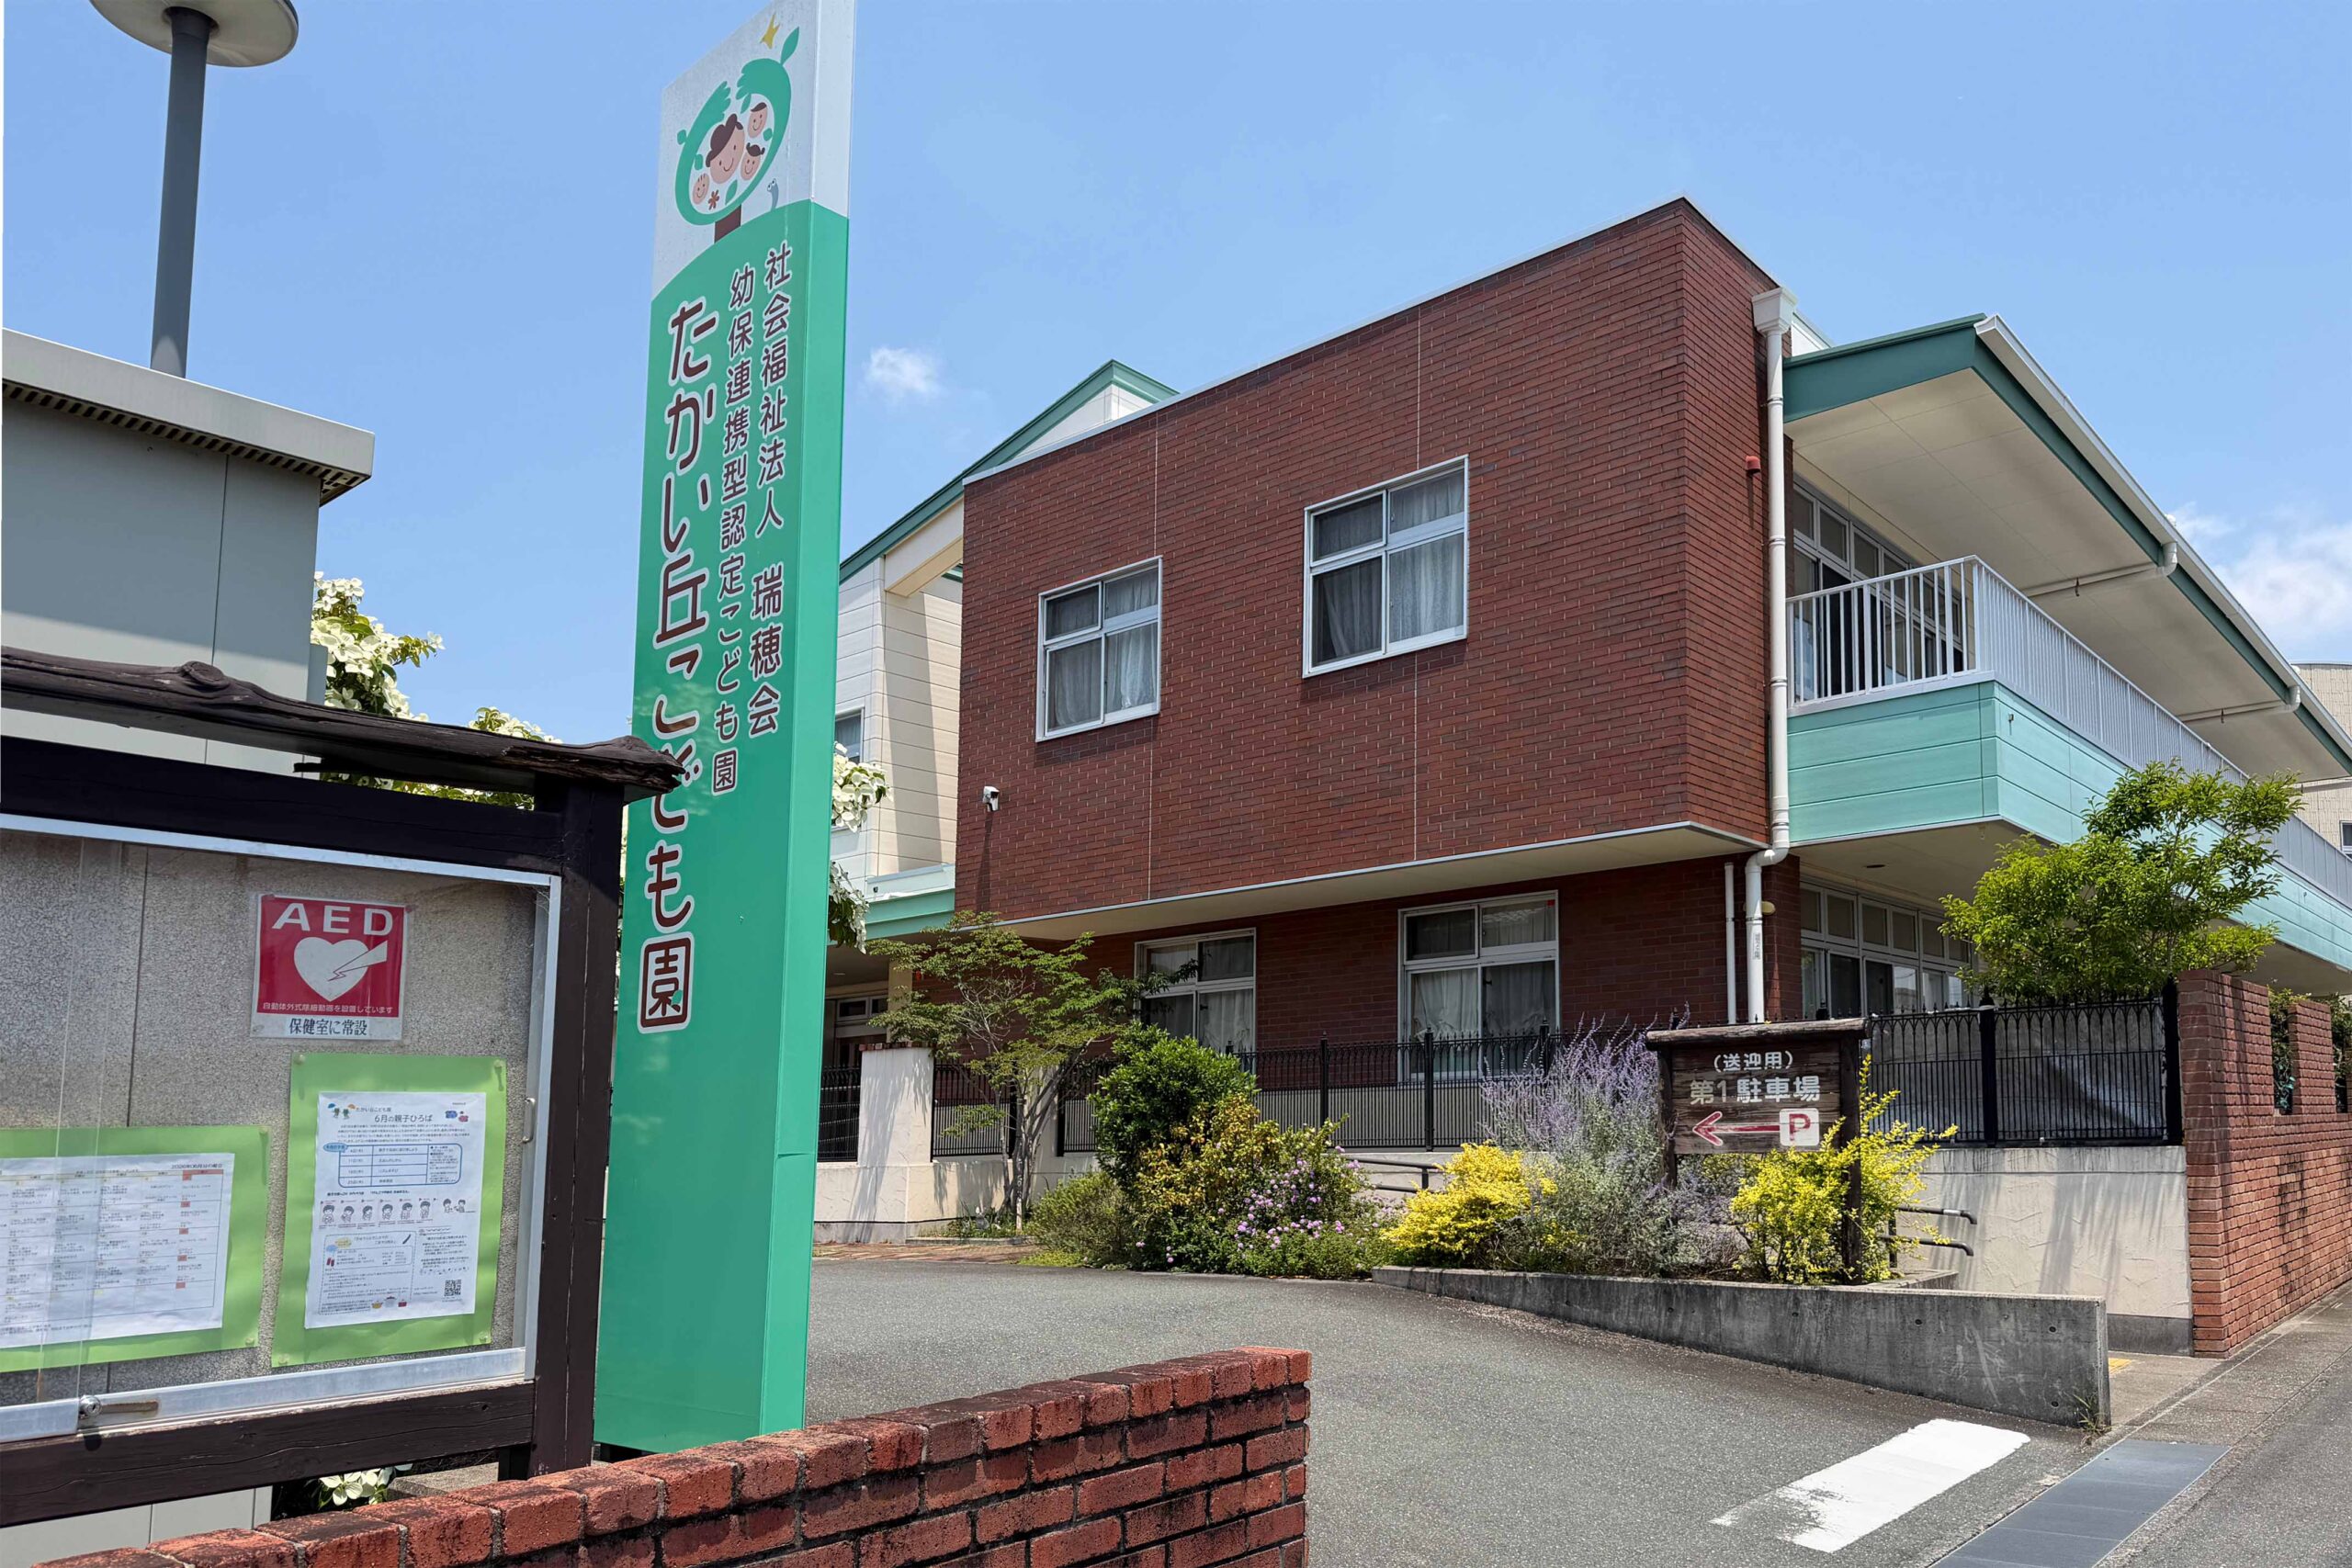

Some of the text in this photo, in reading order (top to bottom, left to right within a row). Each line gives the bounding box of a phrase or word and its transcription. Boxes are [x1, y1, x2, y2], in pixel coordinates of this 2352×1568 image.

[748, 241, 791, 738] 社会福祉法人 瑞穂会
[712, 268, 754, 795] 幼保連携型認定こども園
[272, 902, 393, 937] AED
[289, 1018, 368, 1036] 保健室に常設
[1690, 1075, 1822, 1105] 第1駐車場
[374, 1112, 433, 1122] 6月の親子ひろば
[1789, 1112, 1811, 1141] P
